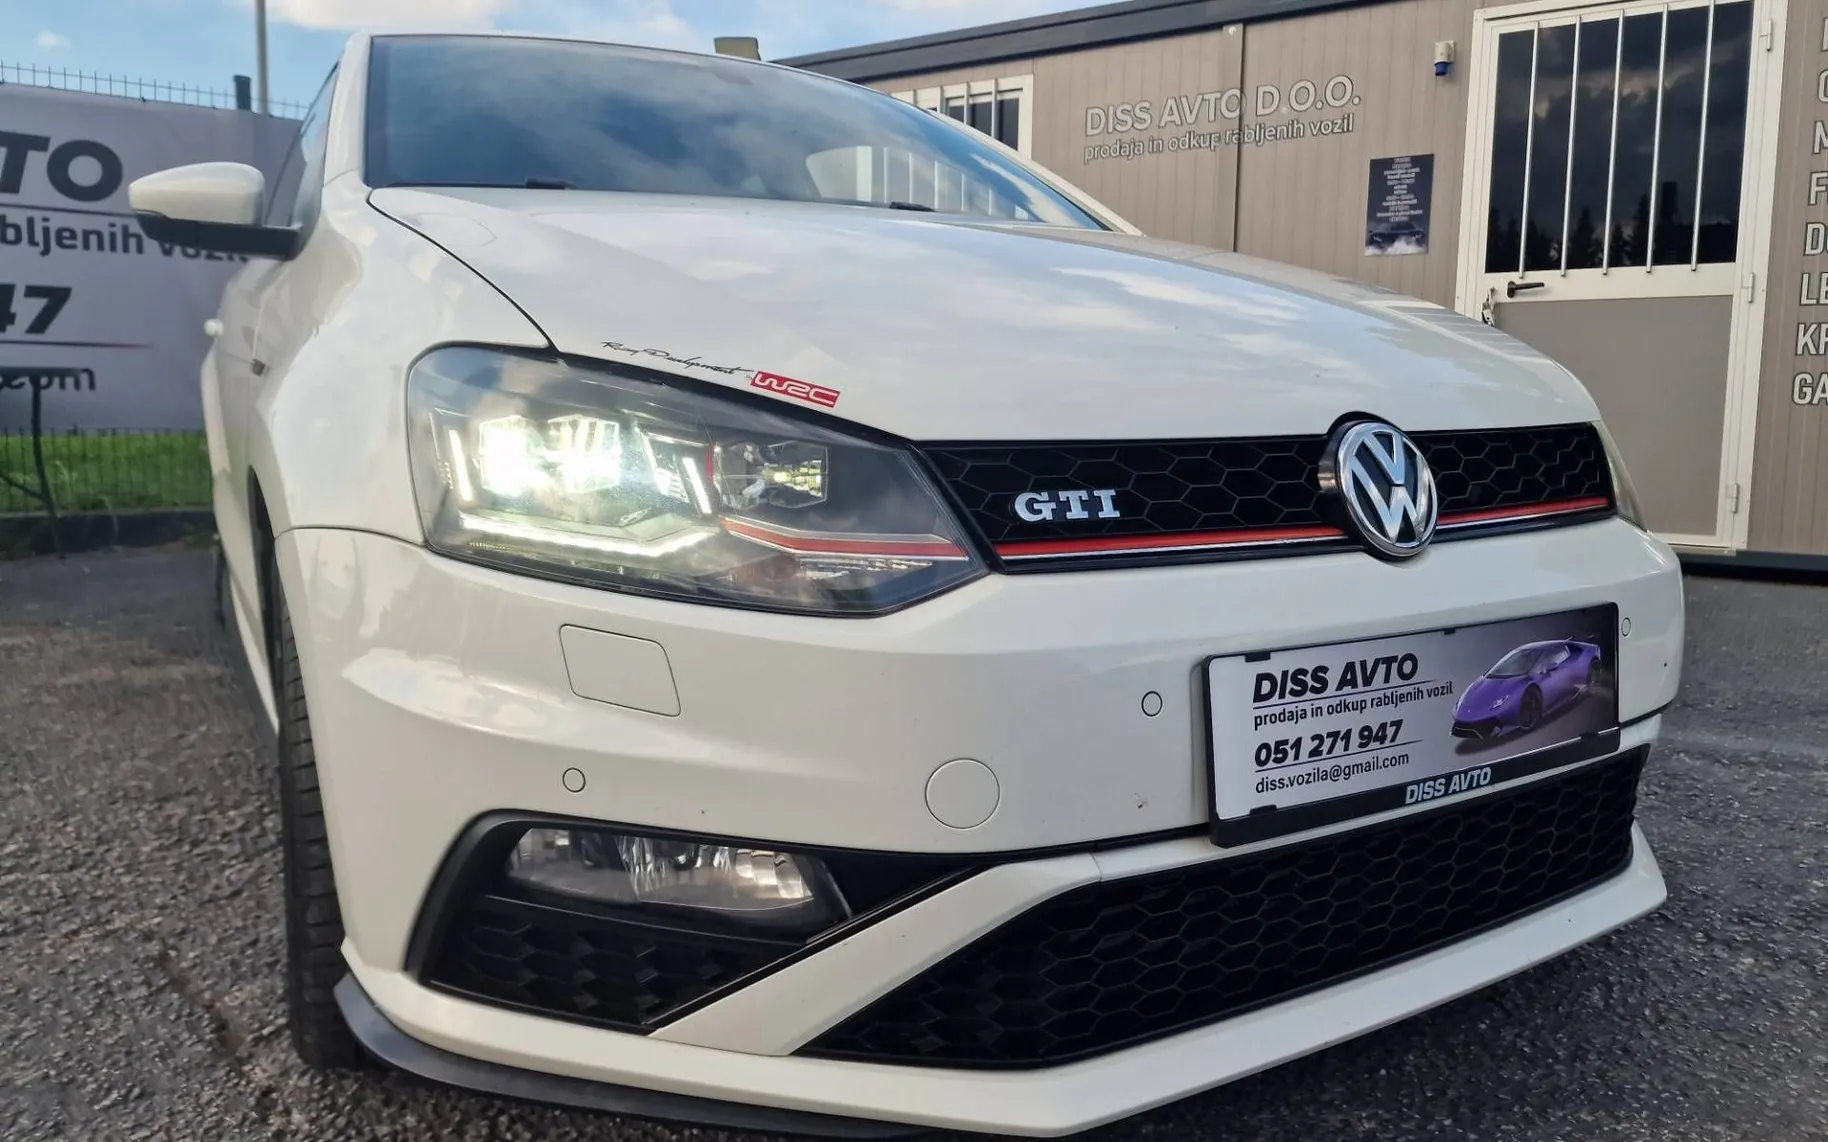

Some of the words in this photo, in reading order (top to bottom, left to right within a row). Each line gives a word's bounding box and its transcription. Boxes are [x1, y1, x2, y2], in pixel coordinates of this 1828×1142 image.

[1085, 101, 1152, 136] DISS
[1158, 88, 1246, 128] AVTO
[1255, 74, 1361, 116] D.O.O.
[1083, 141, 1143, 164] prodaja
[1148, 135, 1163, 153] in
[1168, 130, 1220, 151] odkup
[1225, 121, 1304, 146] rabljenih
[1310, 112, 1354, 136] vozil
[0, 130, 123, 202] TO
[754, 373, 838, 405] WRC
[1014, 489, 1120, 522] GTI
[1253, 665, 1329, 703] DISS
[1335, 653, 1418, 691] AVTO
[1254, 705, 1307, 730] prodaja
[1311, 704, 1323, 718] in
[1327, 698, 1366, 714] odkup
[1370, 687, 1423, 708] rabljenih
[1428, 681, 1453, 698] vozil
[1255, 737, 1302, 767] 051
[1308, 728, 1352, 758] 271
[1358, 719, 1403, 749] 947
[1256, 753, 1409, 794] diss.vozila@gmail.com
[1405, 778, 1446, 804] DISS
[1448, 767, 1491, 793] AVTO
